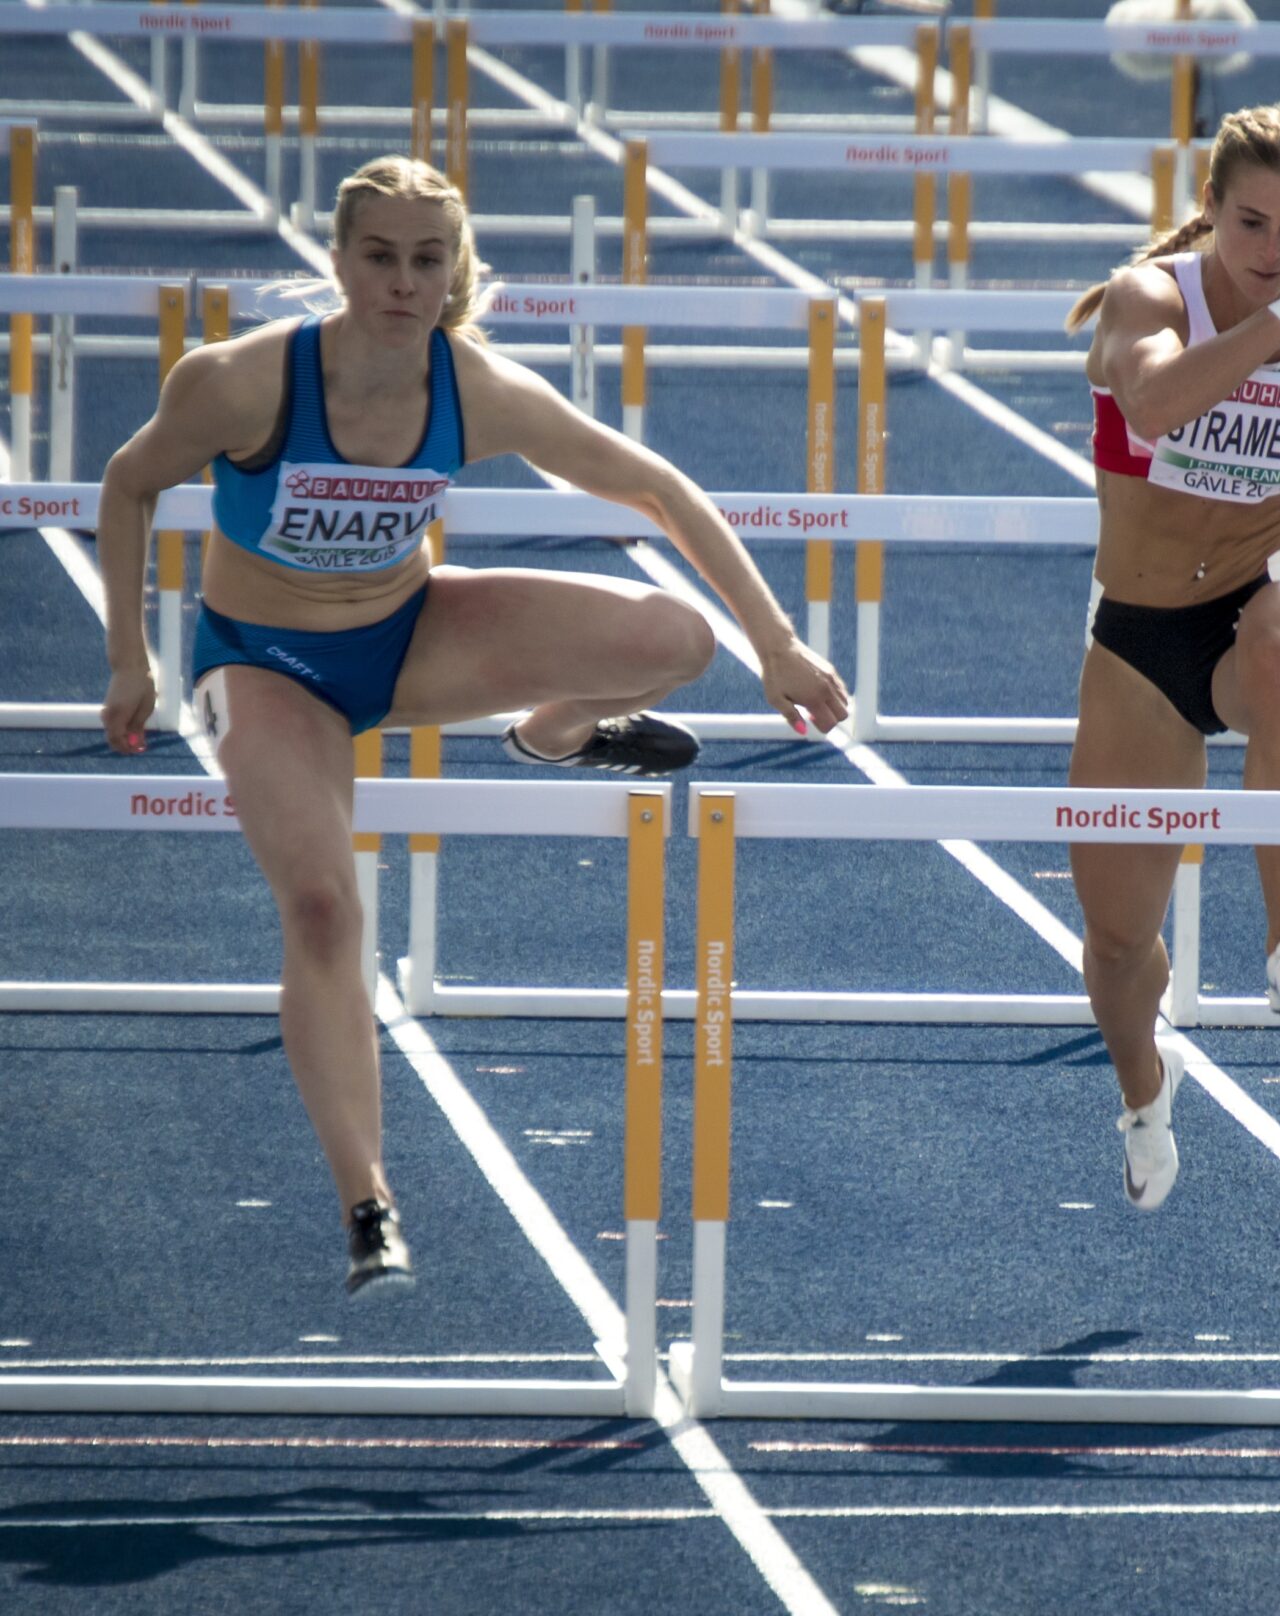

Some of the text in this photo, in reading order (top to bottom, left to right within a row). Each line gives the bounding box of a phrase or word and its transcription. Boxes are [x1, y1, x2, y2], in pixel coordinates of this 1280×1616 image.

[904, 146, 949, 165] Sport
[492, 295, 575, 318] dic Sport
[1184, 471, 1241, 496] GÄVLE
[17, 497, 80, 521] Sport
[787, 509, 848, 532] Sport
[266, 646, 313, 676] CRAFT
[1147, 807, 1221, 835] Sport
[633, 1010, 655, 1065] Sport
[702, 1010, 725, 1067] Sport
